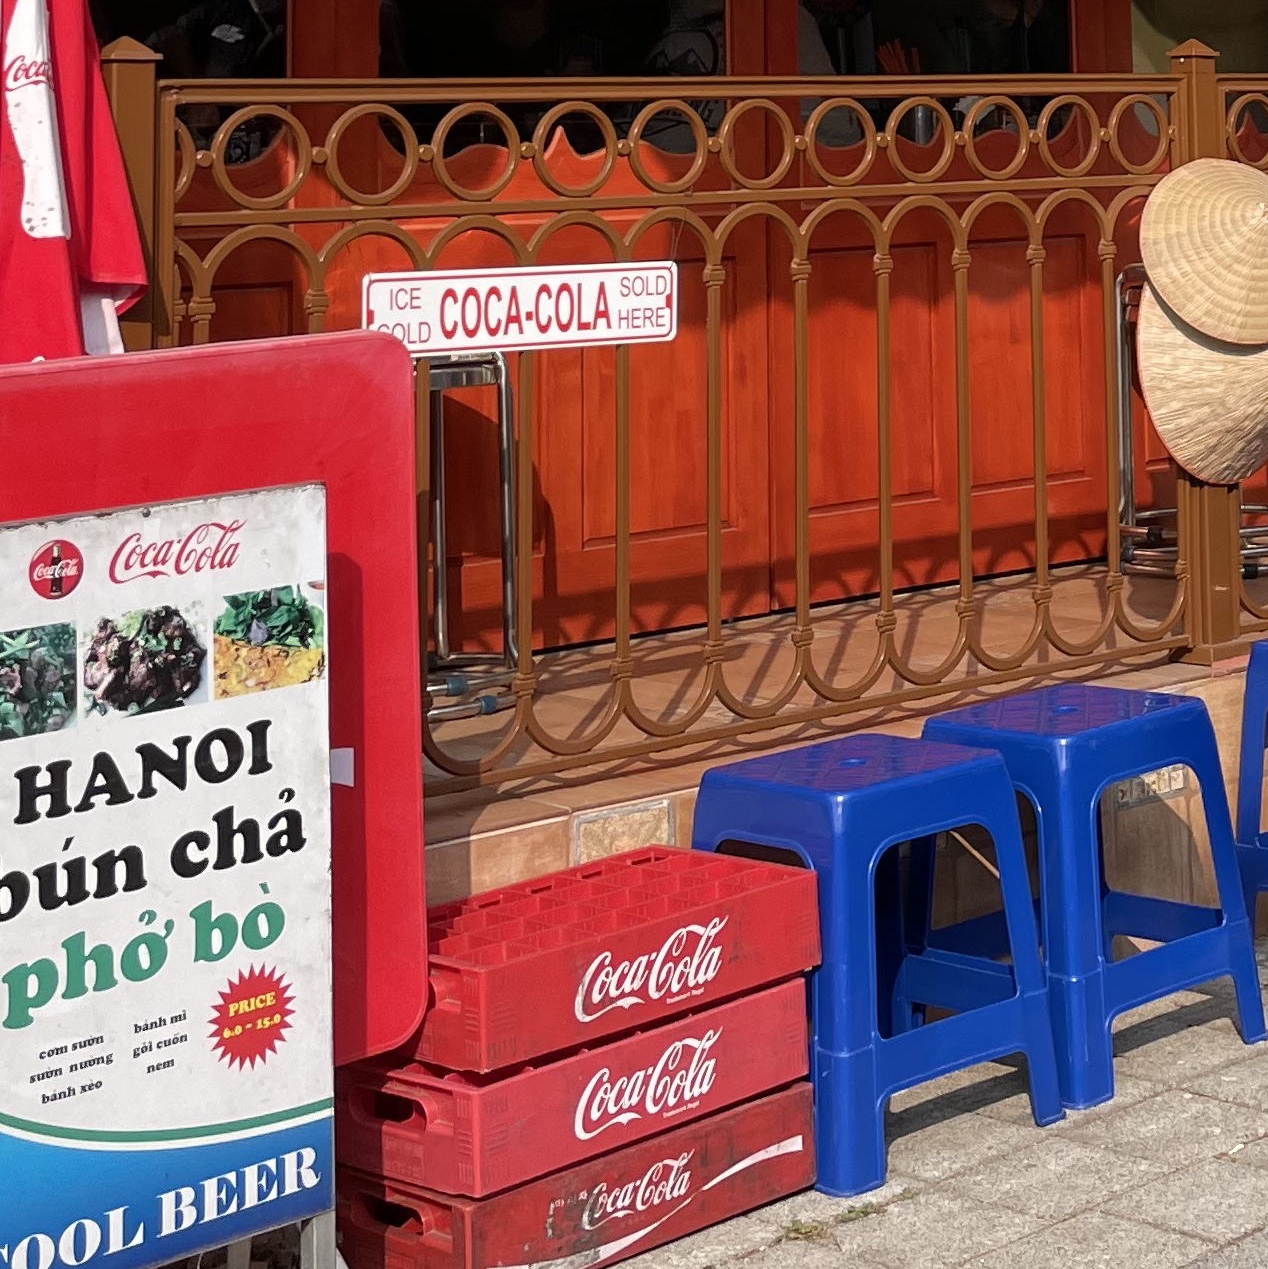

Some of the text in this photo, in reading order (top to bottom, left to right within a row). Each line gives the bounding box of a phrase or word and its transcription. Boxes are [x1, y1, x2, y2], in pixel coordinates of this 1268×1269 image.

[389, 287, 422, 311] ICE
[440, 281, 612, 340] COCA-COLA
[618, 307, 667, 330] HERE
[620, 275, 667, 298] SOLD
[108, 519, 247, 584] Coca-Cola
[13, 719, 273, 825] HANOI
[170, 787, 307, 878] chả
[1, 881, 286, 1030] phở bò
[574, 915, 729, 1023] Coca-Cola
[222, 1024, 243, 1039] 6.0
[256, 1013, 282, 1030] 15.0
[228, 991, 277, 1018] PRICE
[146, 1058, 175, 1074] nem
[574, 1025, 723, 1141] Coca-Cola
[0, 1146, 322, 1269] OOL BEER
[582, 1148, 695, 1231] Coca-Cola
